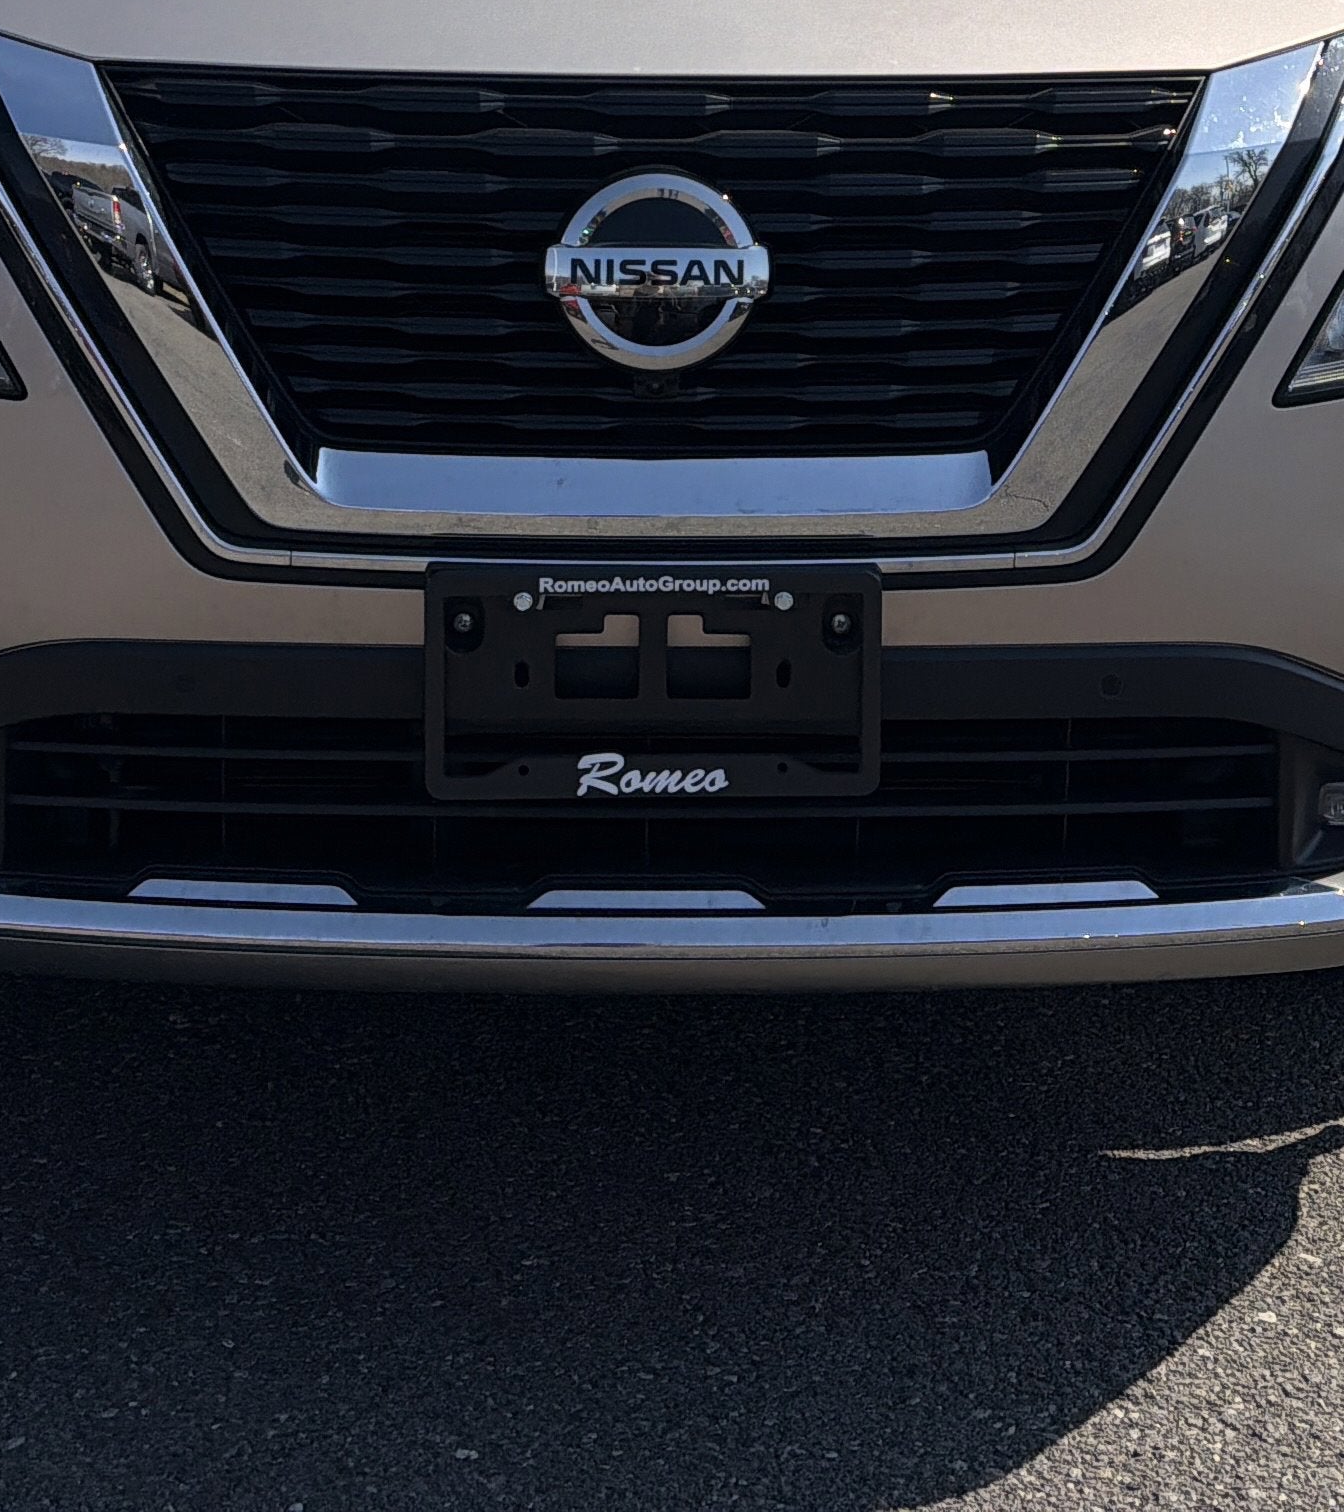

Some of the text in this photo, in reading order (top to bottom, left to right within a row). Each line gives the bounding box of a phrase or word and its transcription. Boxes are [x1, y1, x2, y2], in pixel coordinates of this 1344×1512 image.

[570, 257, 745, 286] NISSAN
[538, 575, 770, 594] RomeoAutoGroup.com
[576, 752, 730, 797] Romeo
